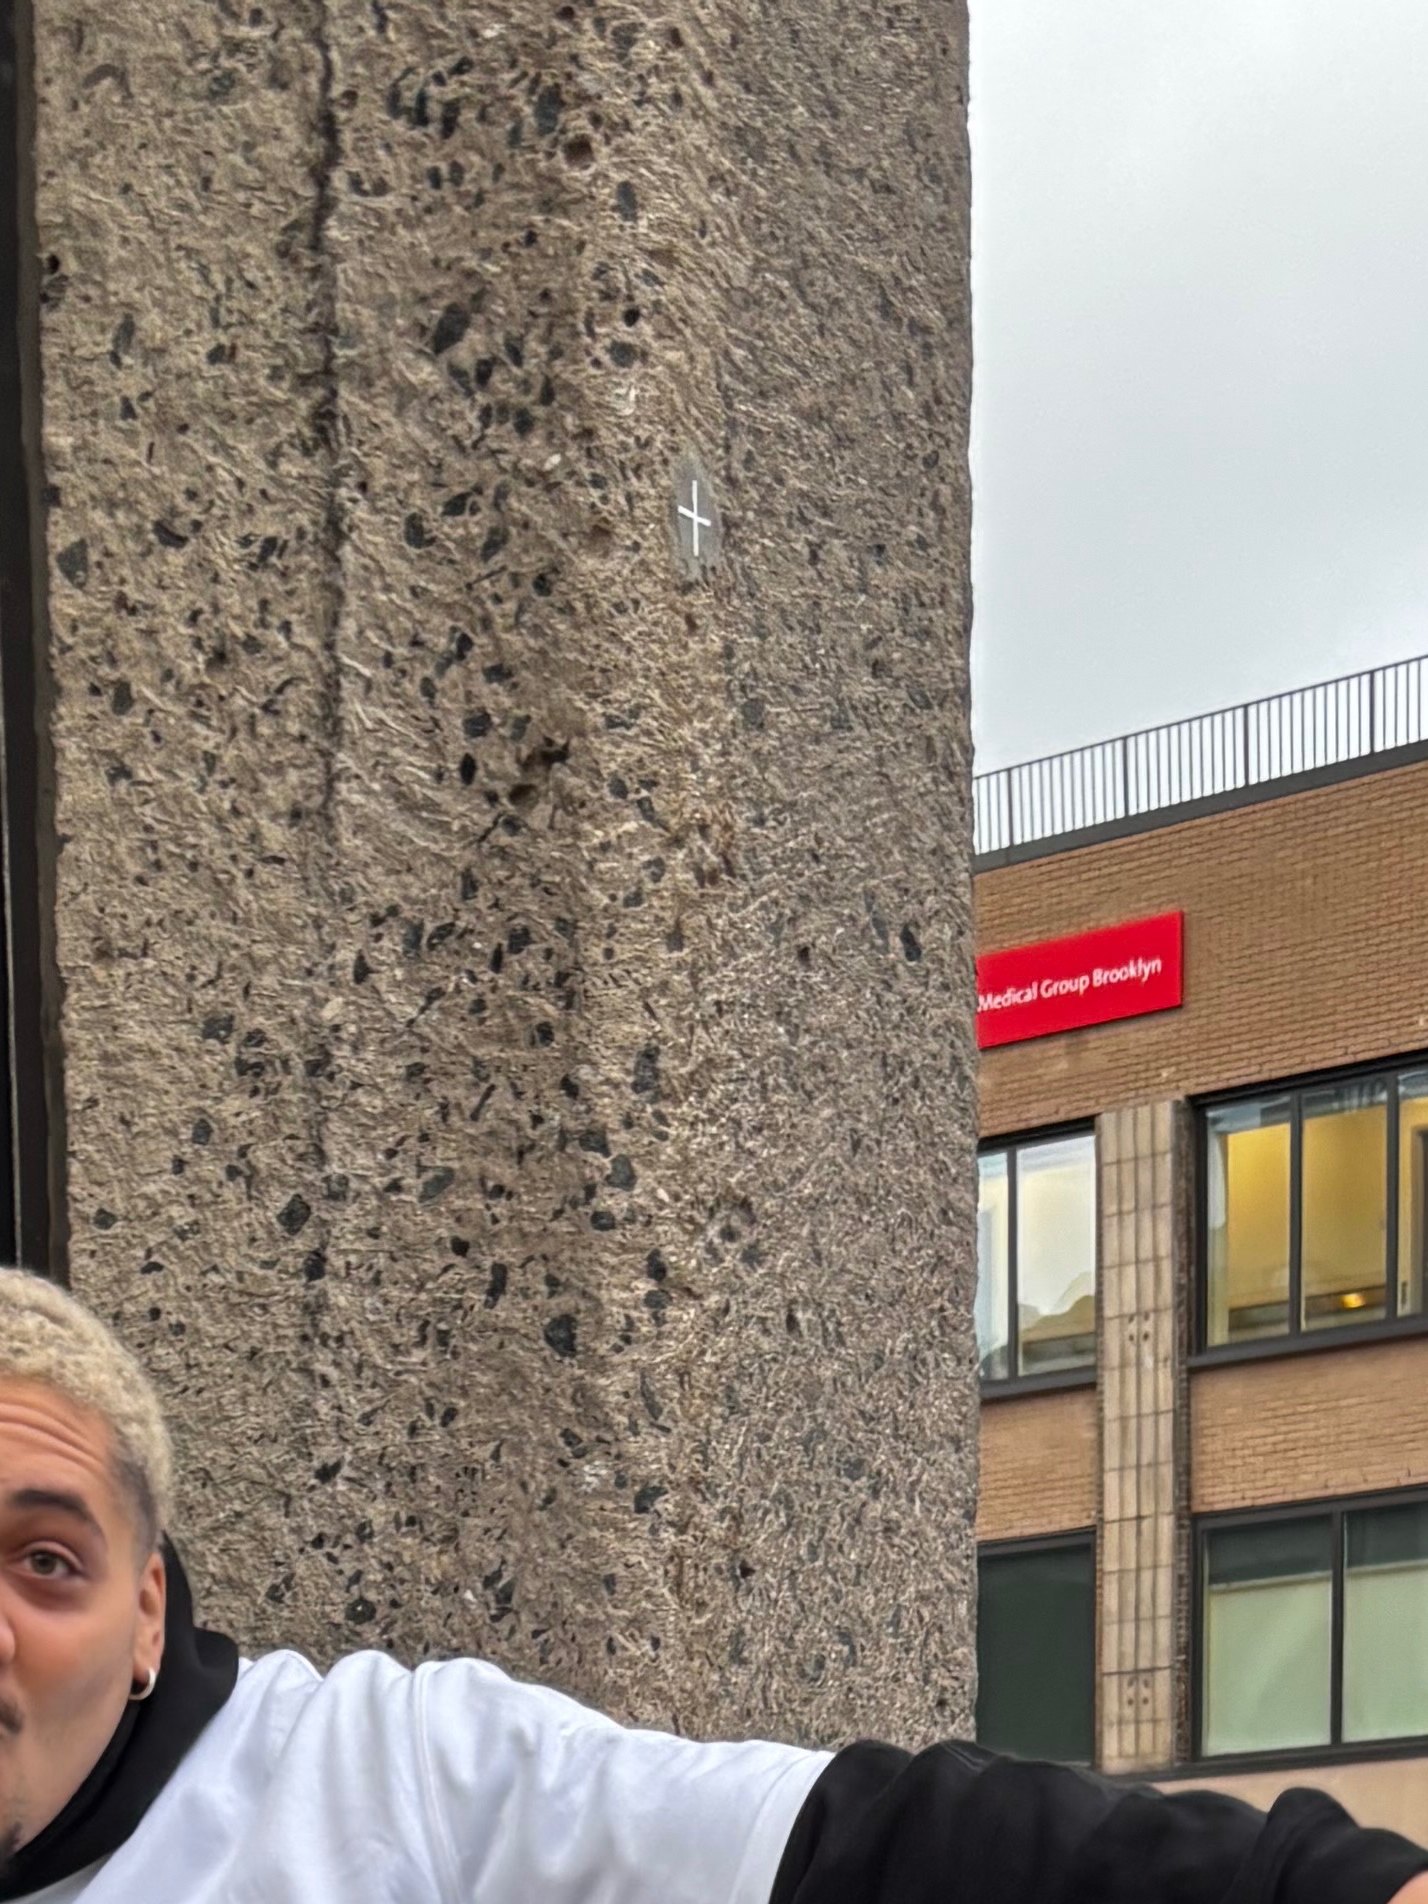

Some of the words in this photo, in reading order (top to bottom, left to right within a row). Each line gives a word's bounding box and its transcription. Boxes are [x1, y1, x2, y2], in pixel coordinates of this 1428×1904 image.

[977, 981, 1038, 1012] Medical
[1040, 973, 1090, 999] Group
[1092, 957, 1162, 988] Brooklyn
